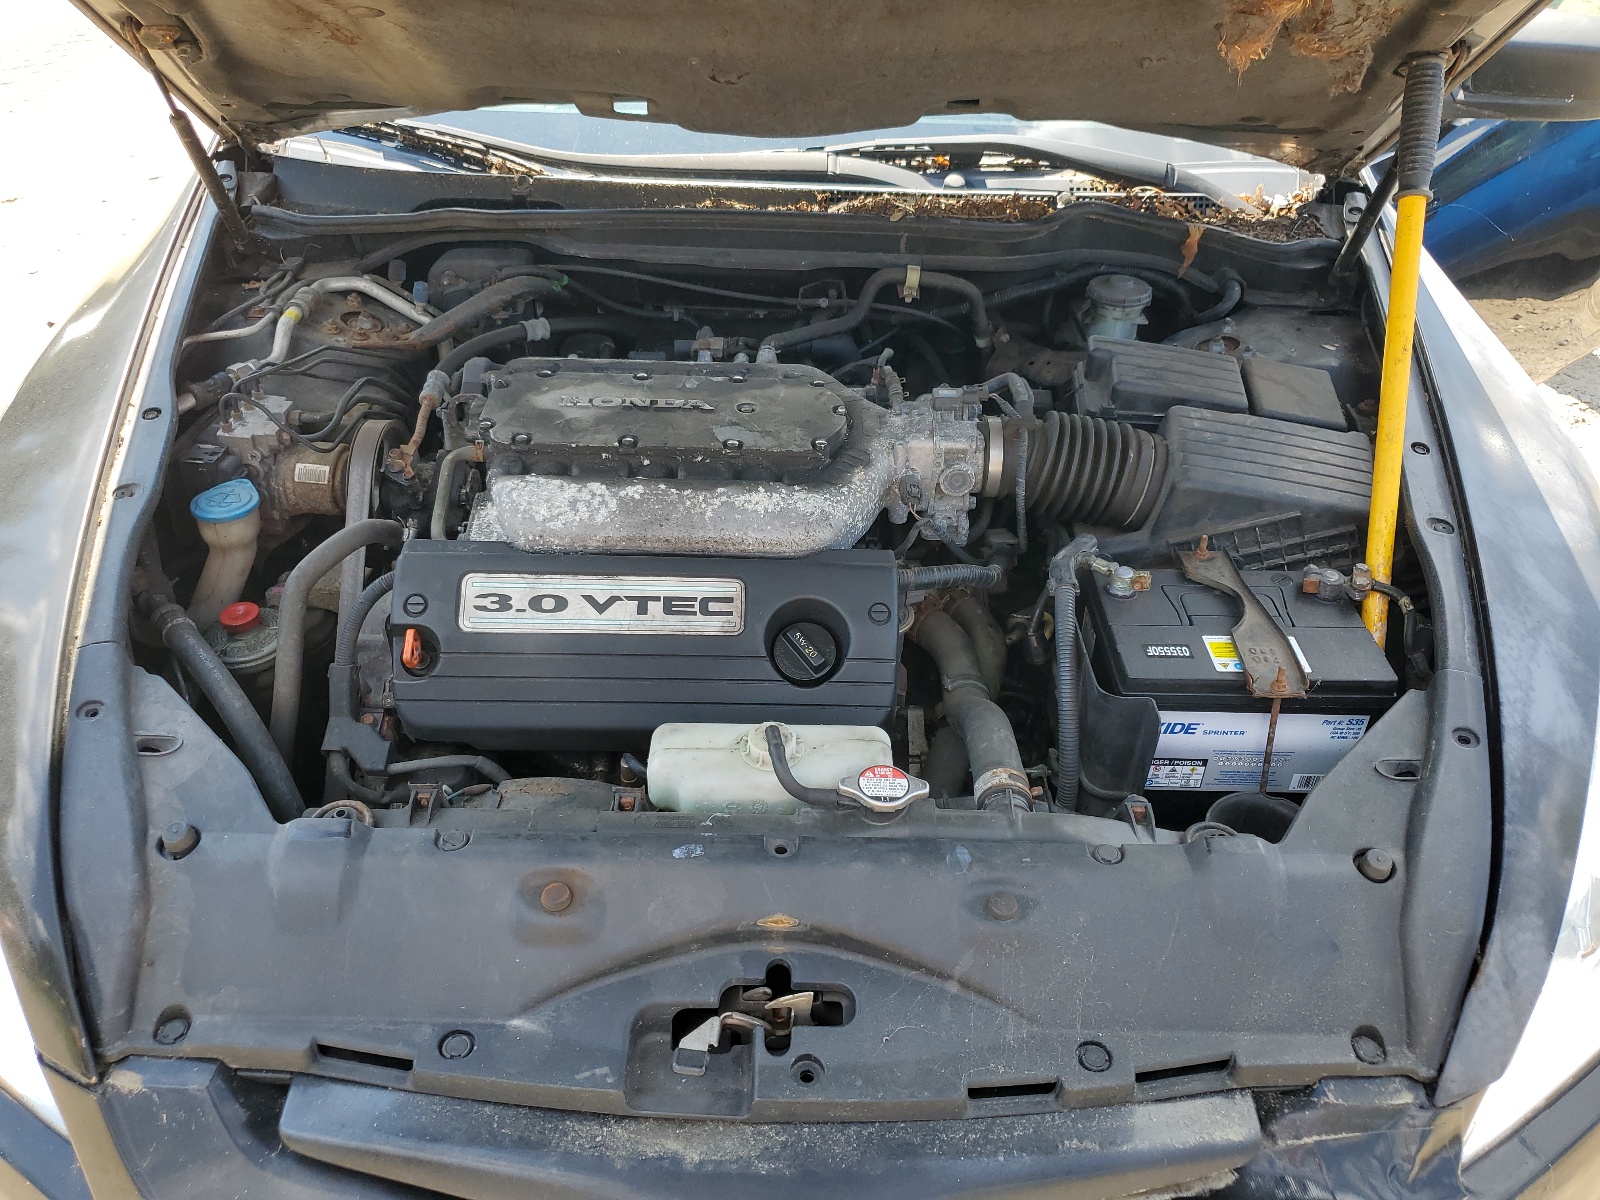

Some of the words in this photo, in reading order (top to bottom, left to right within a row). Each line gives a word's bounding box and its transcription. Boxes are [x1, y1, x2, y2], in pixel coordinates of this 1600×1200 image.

[557, 395, 715, 410] HONDA
[472, 593, 569, 613] 3.0
[580, 594, 735, 617] VTEC
[793, 632, 818, 658] 5W-20
[1146, 646, 1190, 657] 035550F
[1346, 718, 1367, 726] S35
